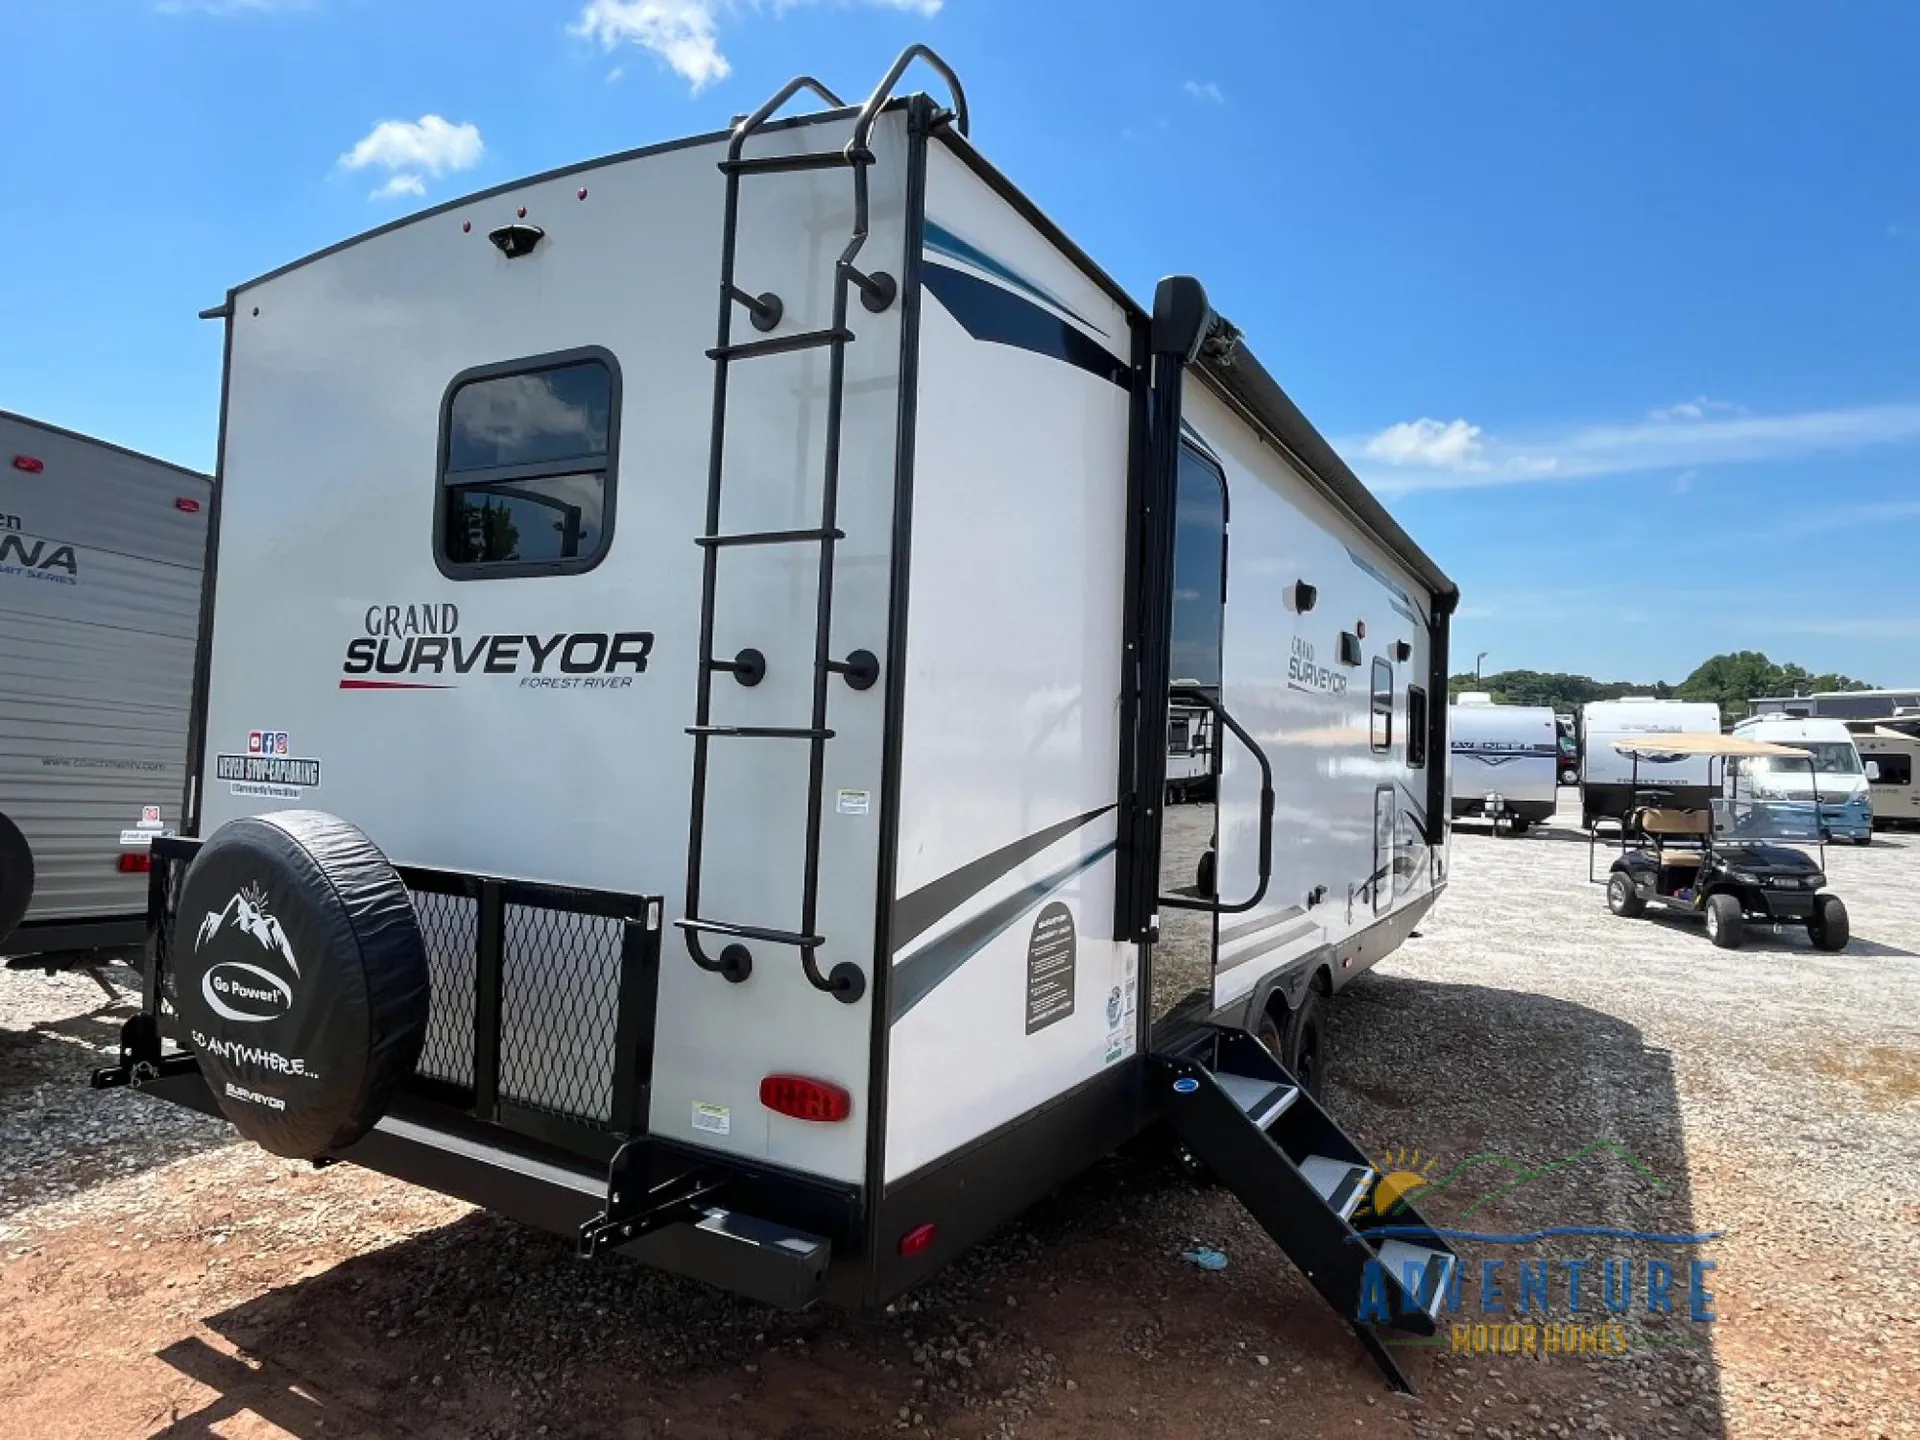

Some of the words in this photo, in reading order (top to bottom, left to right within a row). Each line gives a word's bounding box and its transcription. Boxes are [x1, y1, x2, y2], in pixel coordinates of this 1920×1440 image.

[365, 603, 459, 640] GRAND
[343, 631, 655, 674] SURVEYOR
[519, 676, 578, 689] FOREST
[583, 676, 633, 689] RIVER
[1288, 656, 1347, 694] SURVEYOR
[213, 975, 230, 994] Go
[231, 979, 279, 1005] Power!
[225, 1081, 286, 1112] SURVEYOR
